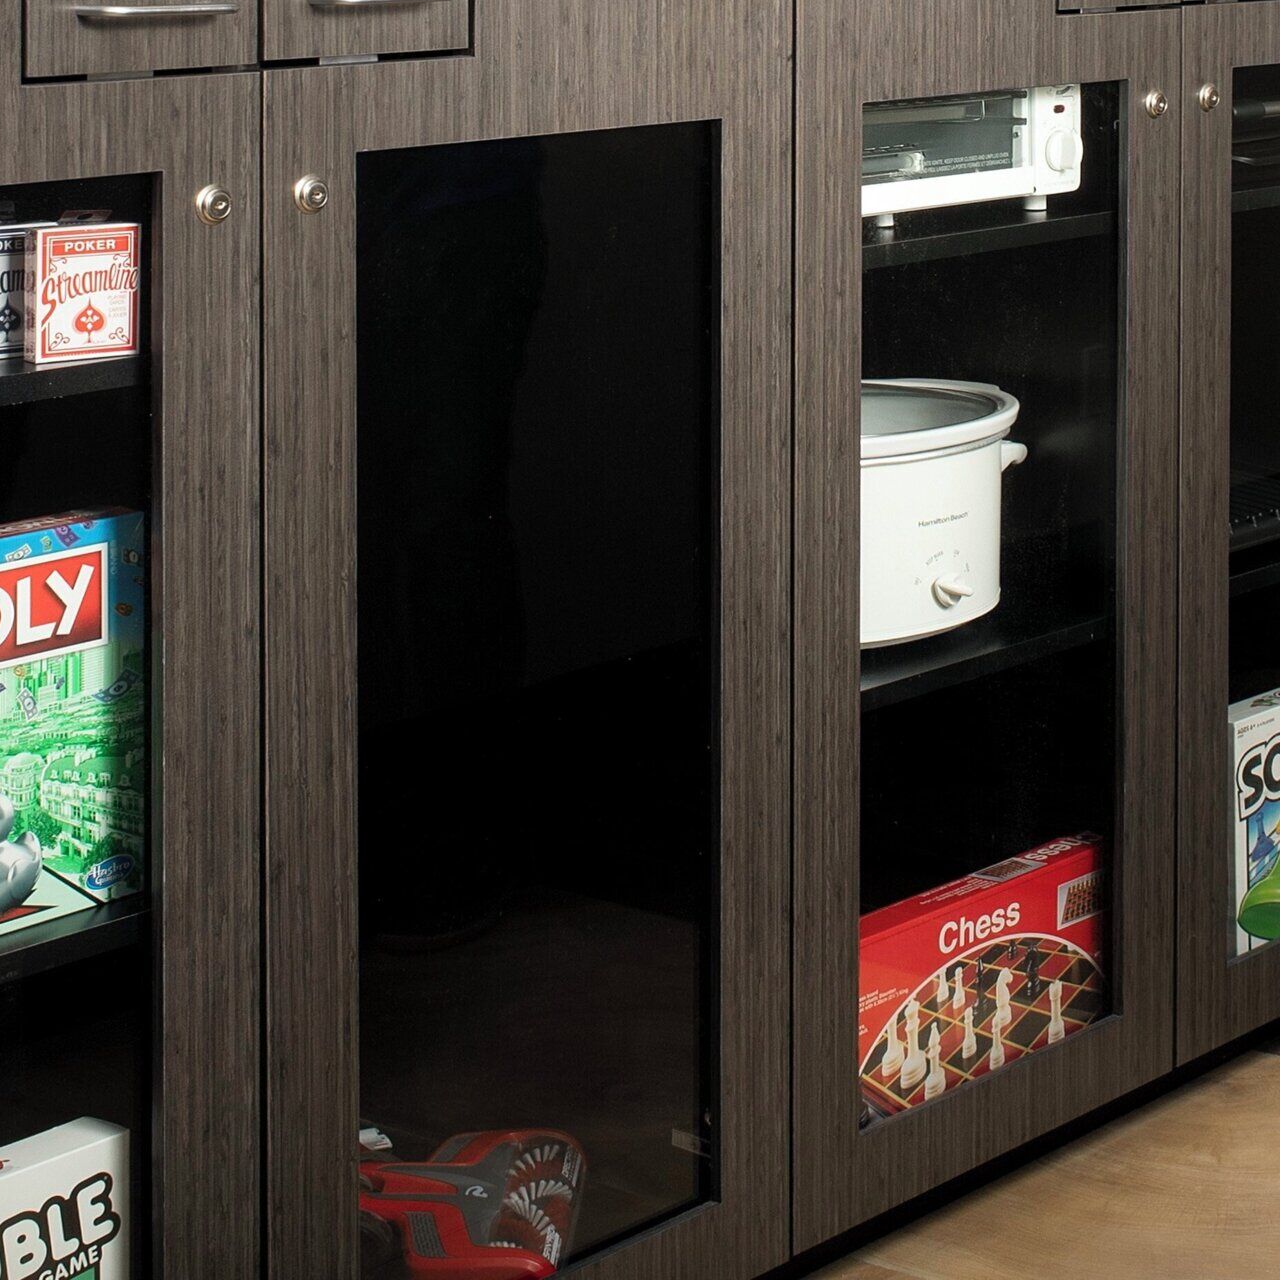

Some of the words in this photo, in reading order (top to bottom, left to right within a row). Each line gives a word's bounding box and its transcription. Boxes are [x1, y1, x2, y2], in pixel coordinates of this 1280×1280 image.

[64, 239, 116, 252] POKER
[41, 262, 139, 325] Streamline
[939, 902, 1021, 954] Chess
[38, 1245, 100, 1280] GAME
